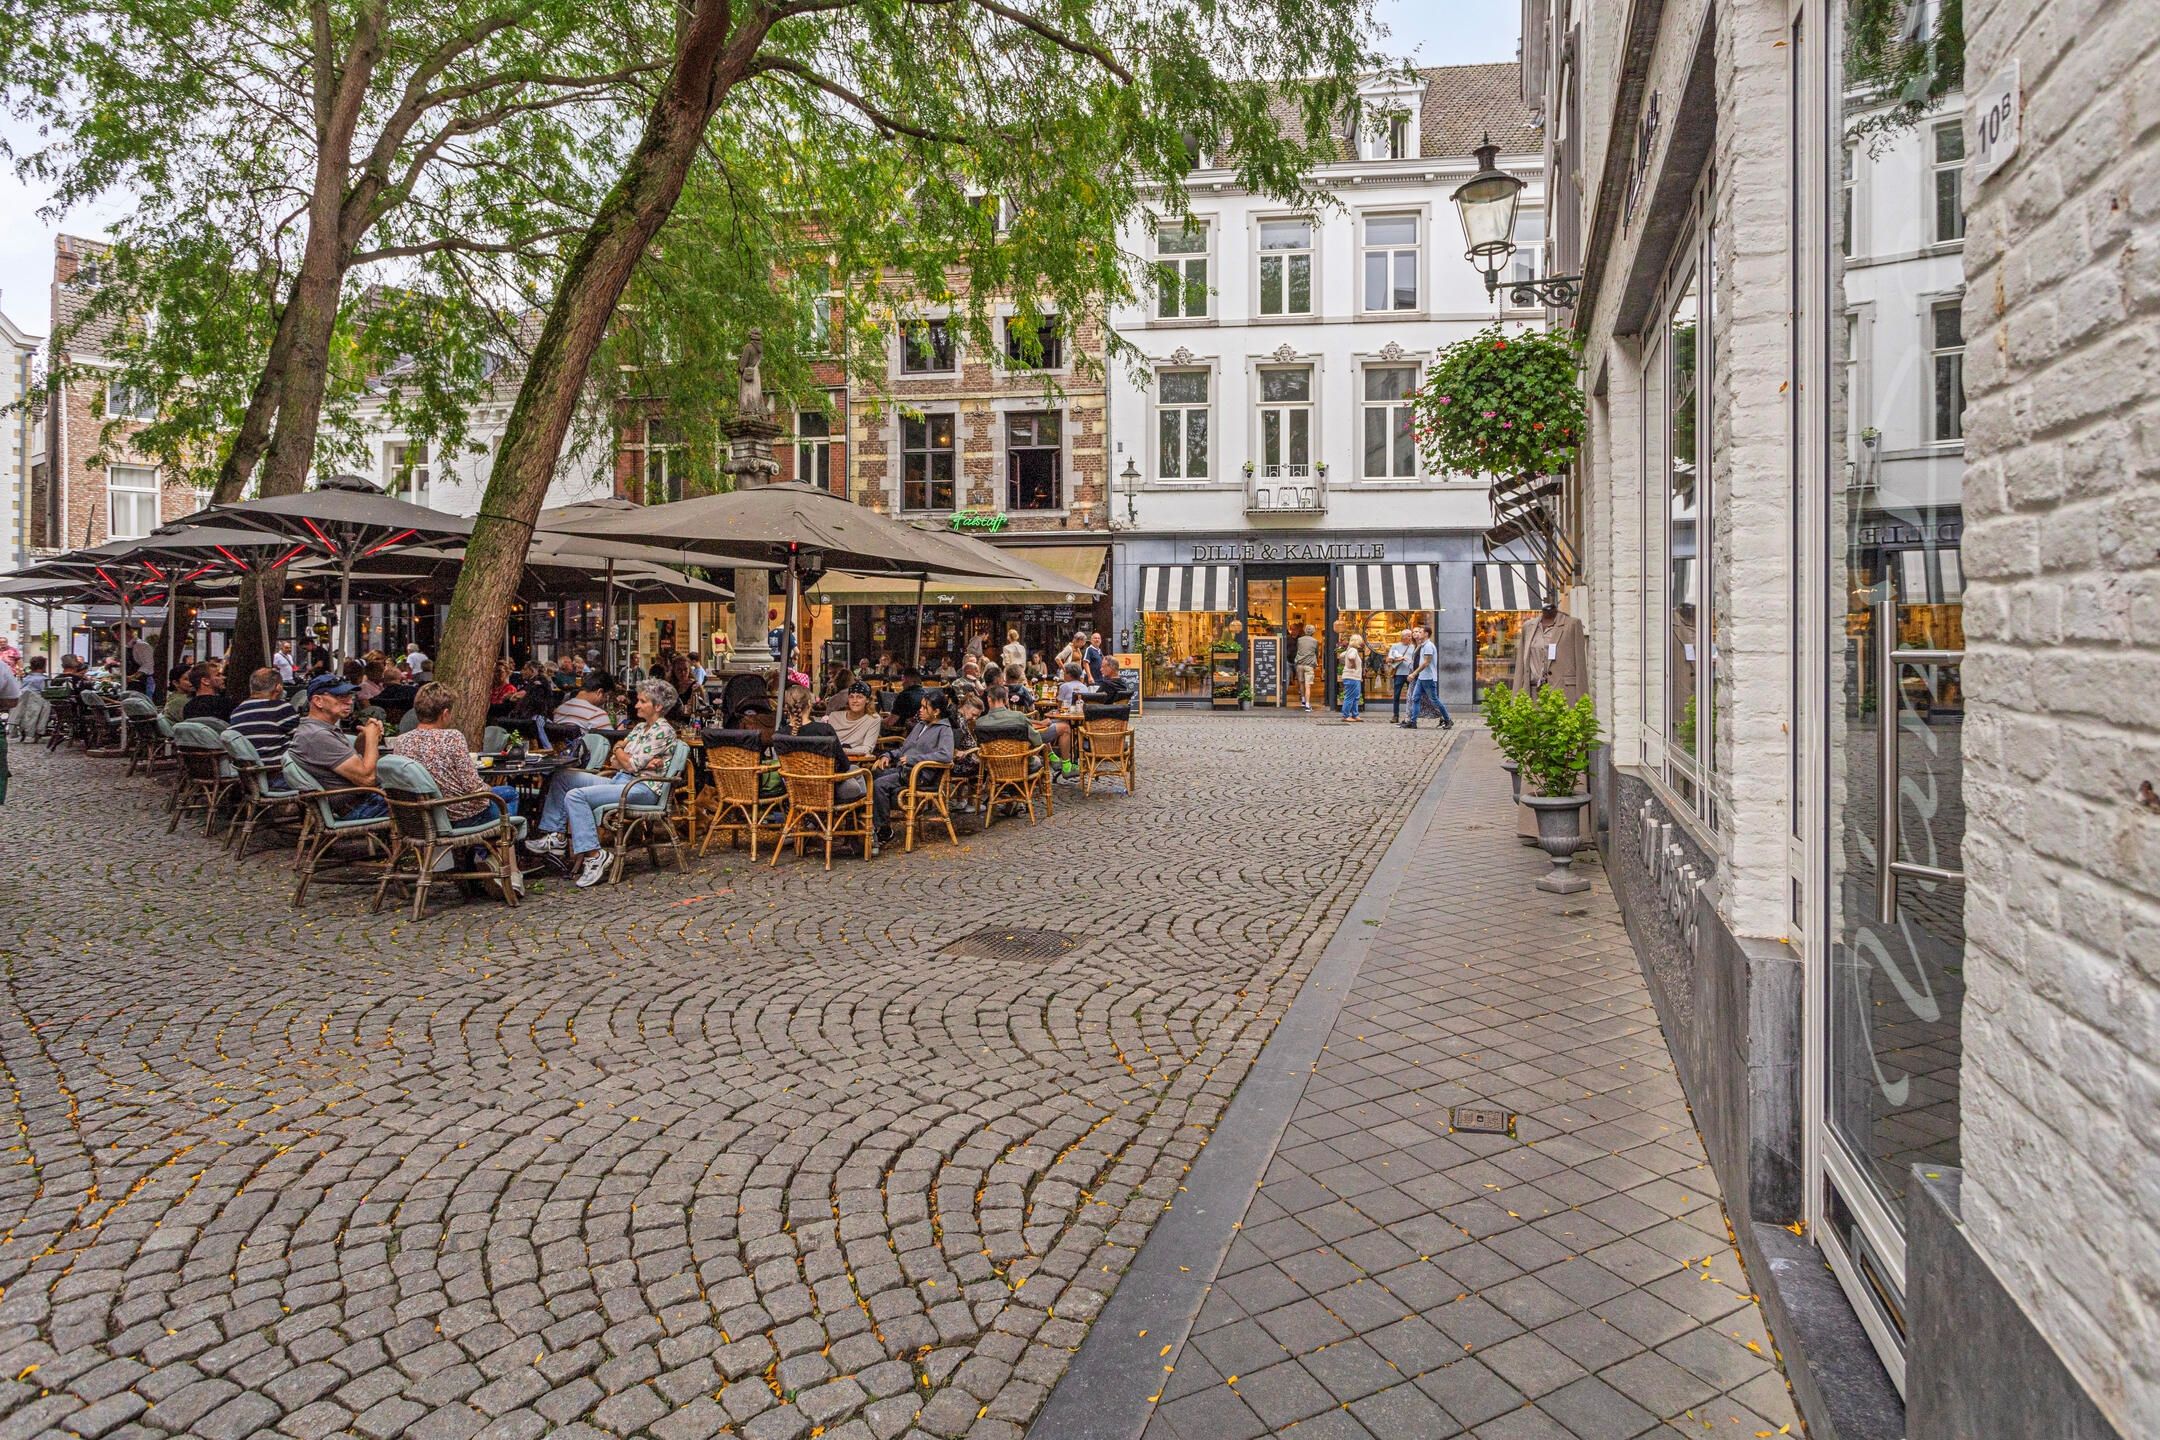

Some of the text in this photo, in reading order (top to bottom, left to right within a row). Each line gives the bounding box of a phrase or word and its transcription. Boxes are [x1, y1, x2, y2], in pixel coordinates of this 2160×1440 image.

[949, 510, 1008, 533] Falstaff
[1192, 544, 1385, 561] DILLE & KAMILLE
